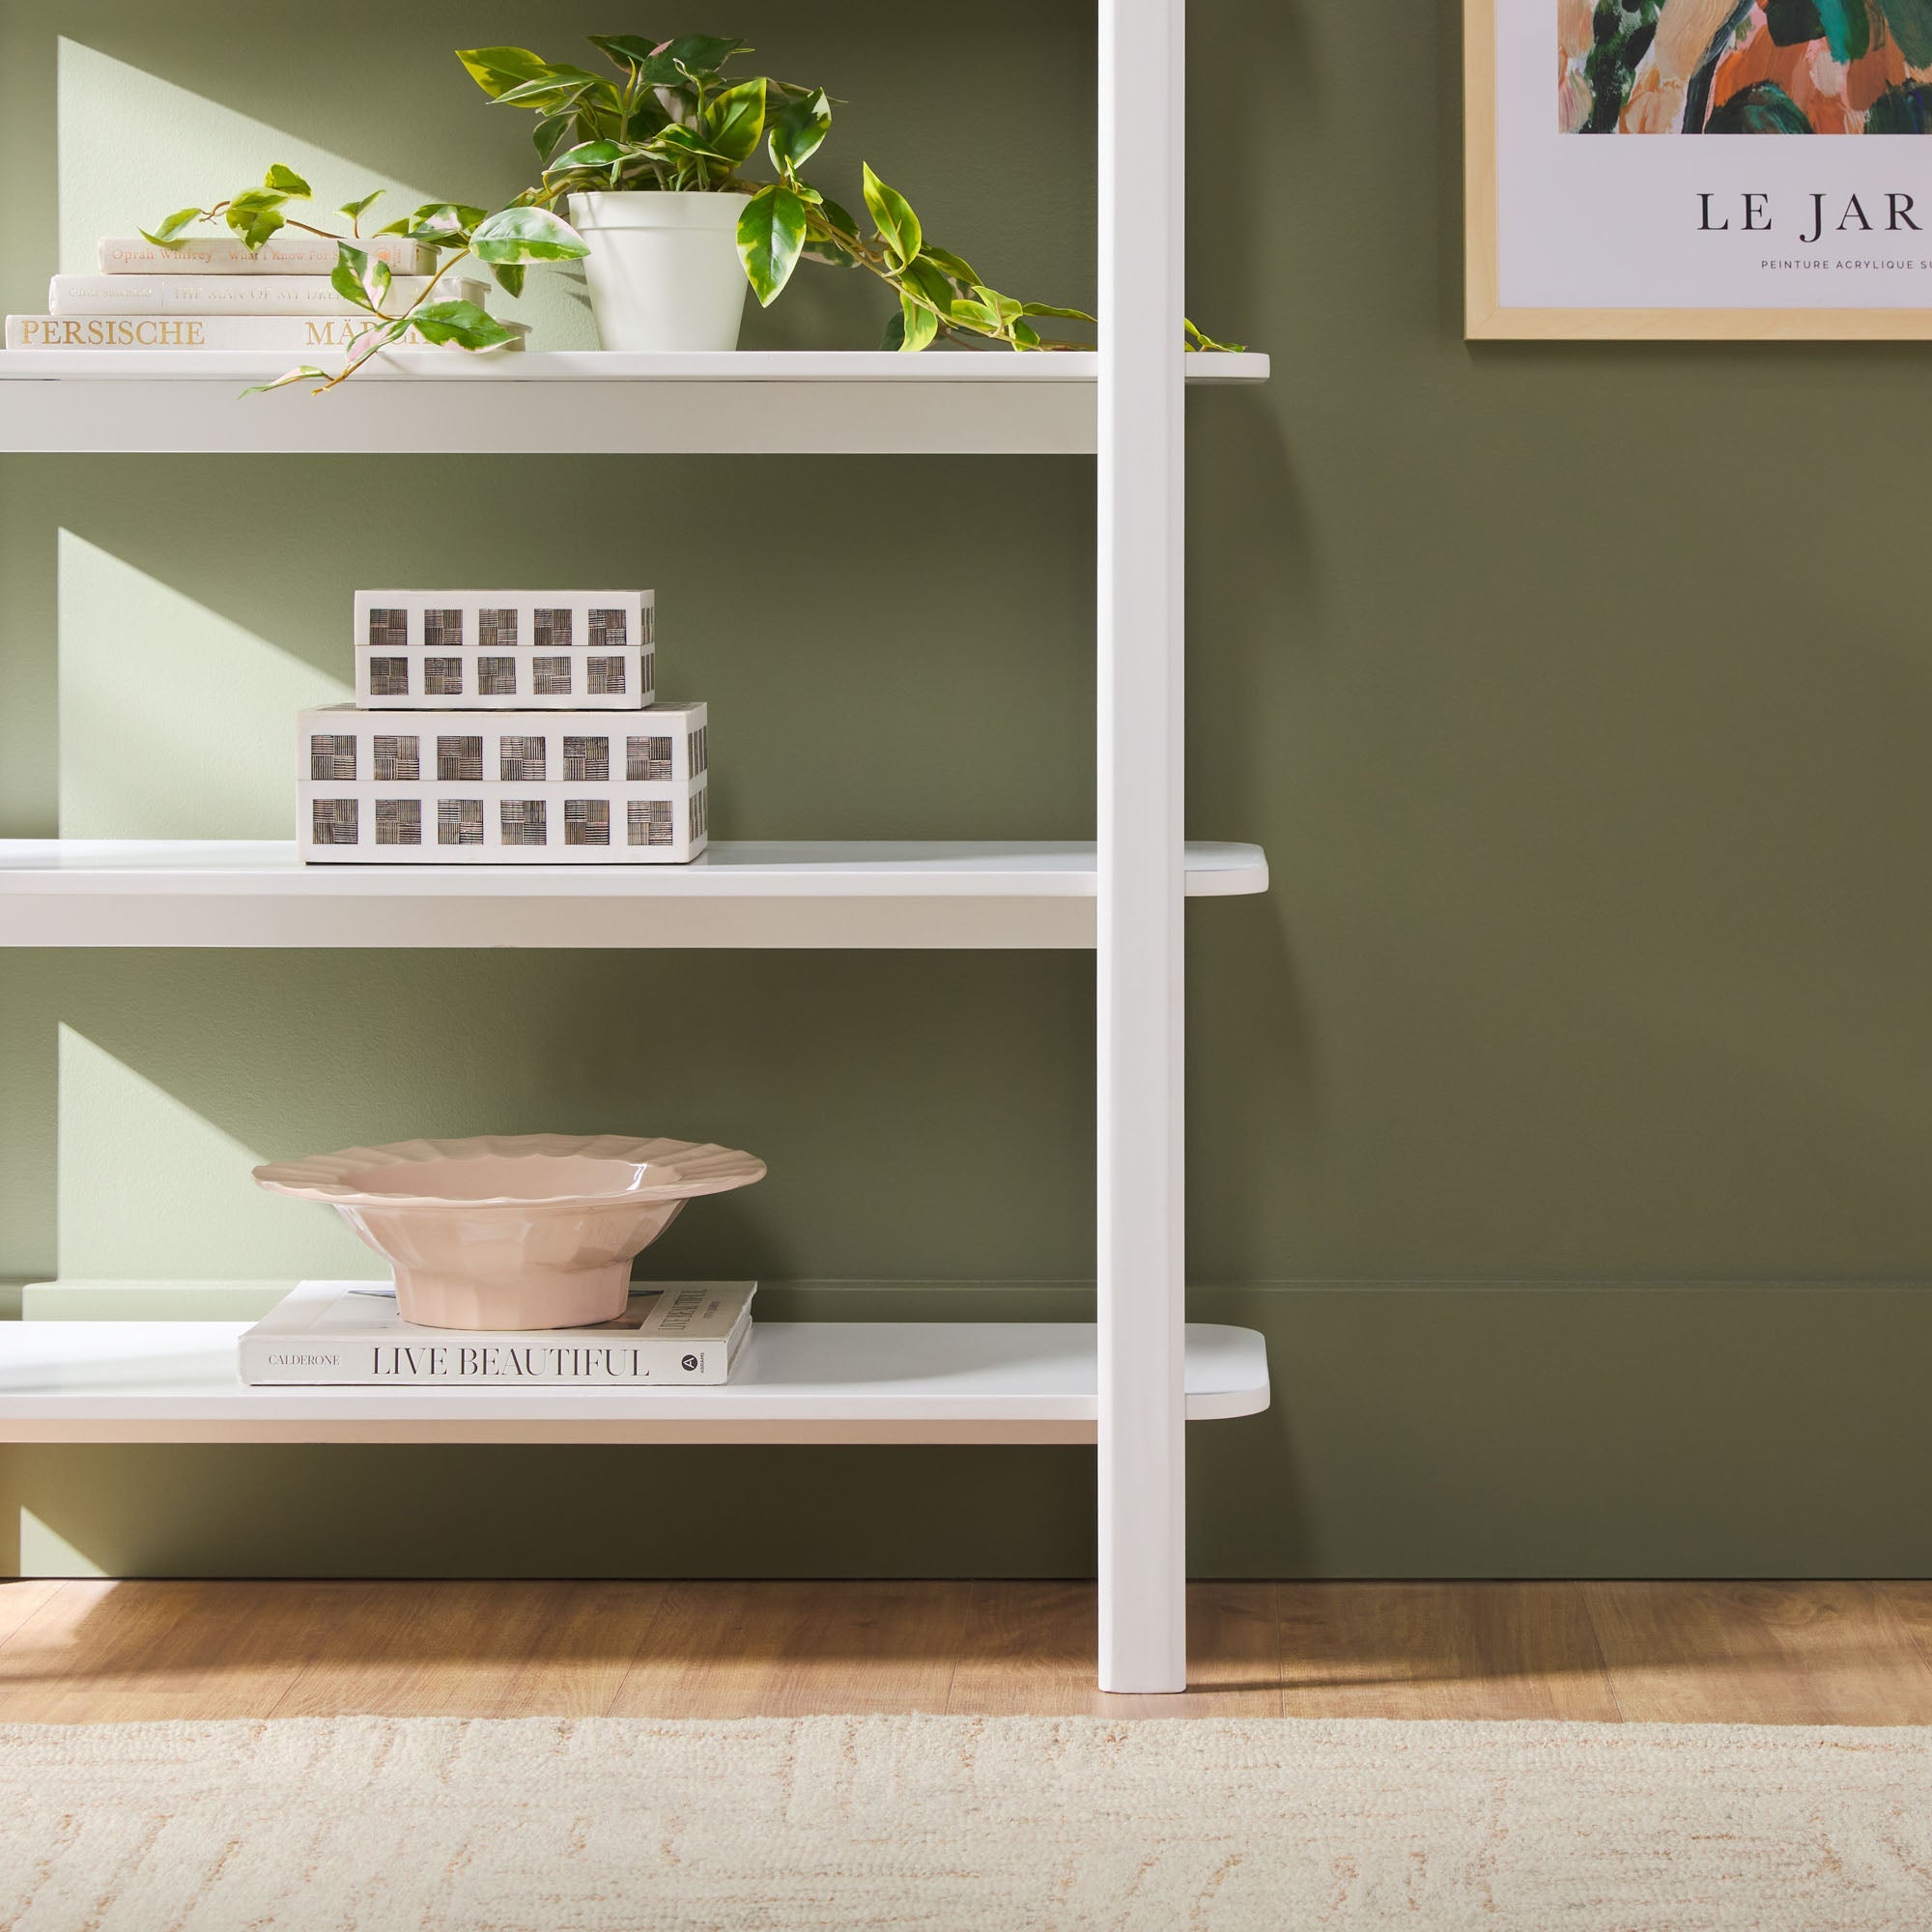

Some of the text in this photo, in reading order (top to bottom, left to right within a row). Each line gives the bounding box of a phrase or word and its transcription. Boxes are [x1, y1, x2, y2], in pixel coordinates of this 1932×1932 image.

[1696, 193, 1924, 243] LE JAR
[112, 248, 155, 264] Oprah
[160, 248, 213, 264] Winfrey
[229, 249, 259, 261] What
[272, 249, 305, 261] Know
[308, 250, 328, 261] For
[1761, 259, 1830, 270] PEINTURE
[1835, 259, 1914, 270] ACRYLIQUE
[21, 320, 206, 346] PERSISCHE
[268, 1347, 650, 1377] CALDERONE LIVE BEAUTIFUL
